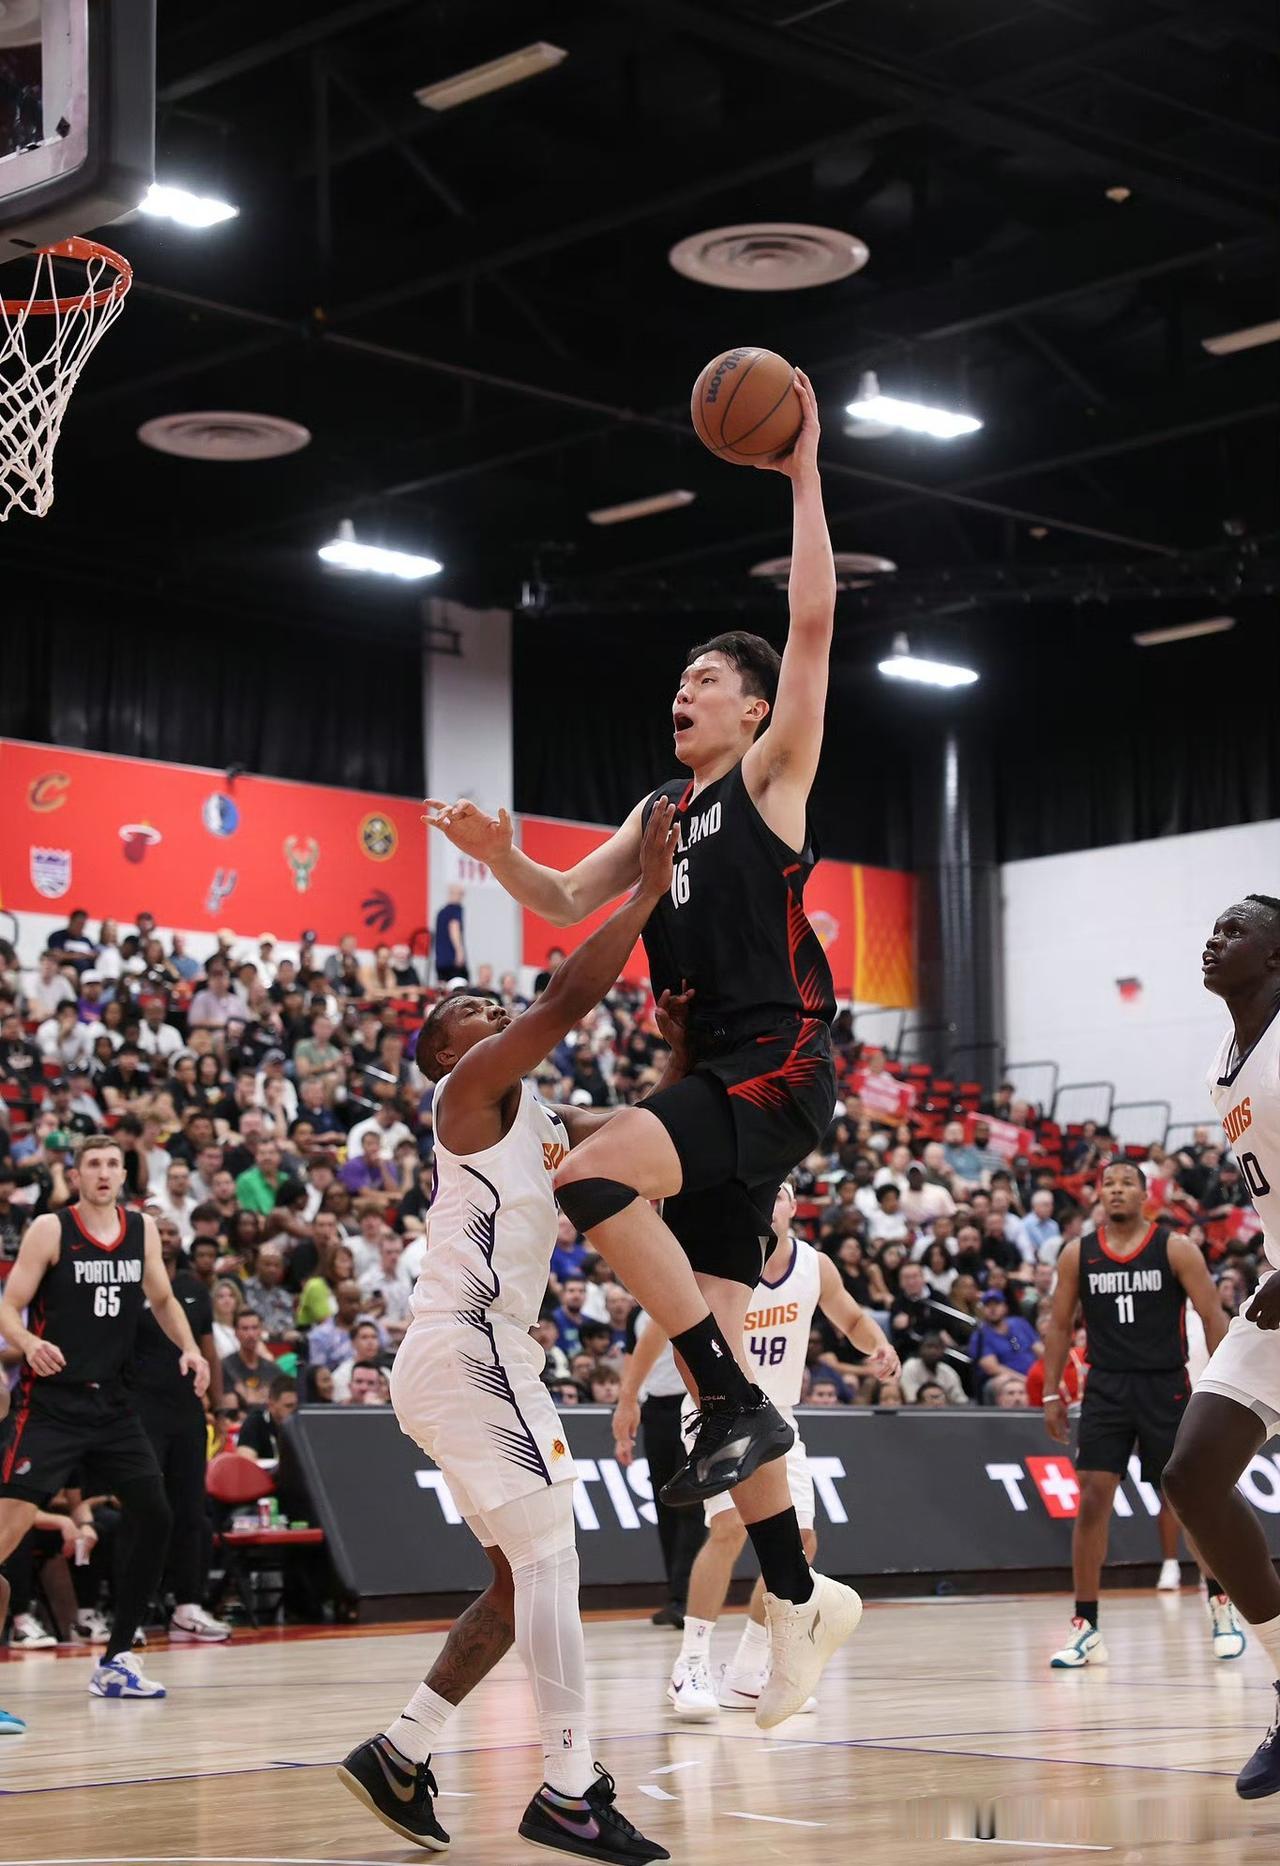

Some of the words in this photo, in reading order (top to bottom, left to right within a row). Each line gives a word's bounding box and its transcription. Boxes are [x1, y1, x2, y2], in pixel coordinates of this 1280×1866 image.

[673, 801, 722, 853] LAND
[671, 857, 691, 910] 16
[73, 1259, 142, 1284] PORTLAND
[1087, 1269, 1162, 1295] PORTLAND
[93, 1285, 121, 1318] 65
[743, 1302, 799, 1331] SUNS
[1114, 1294, 1135, 1325] 11
[750, 1336, 787, 1366] 48
